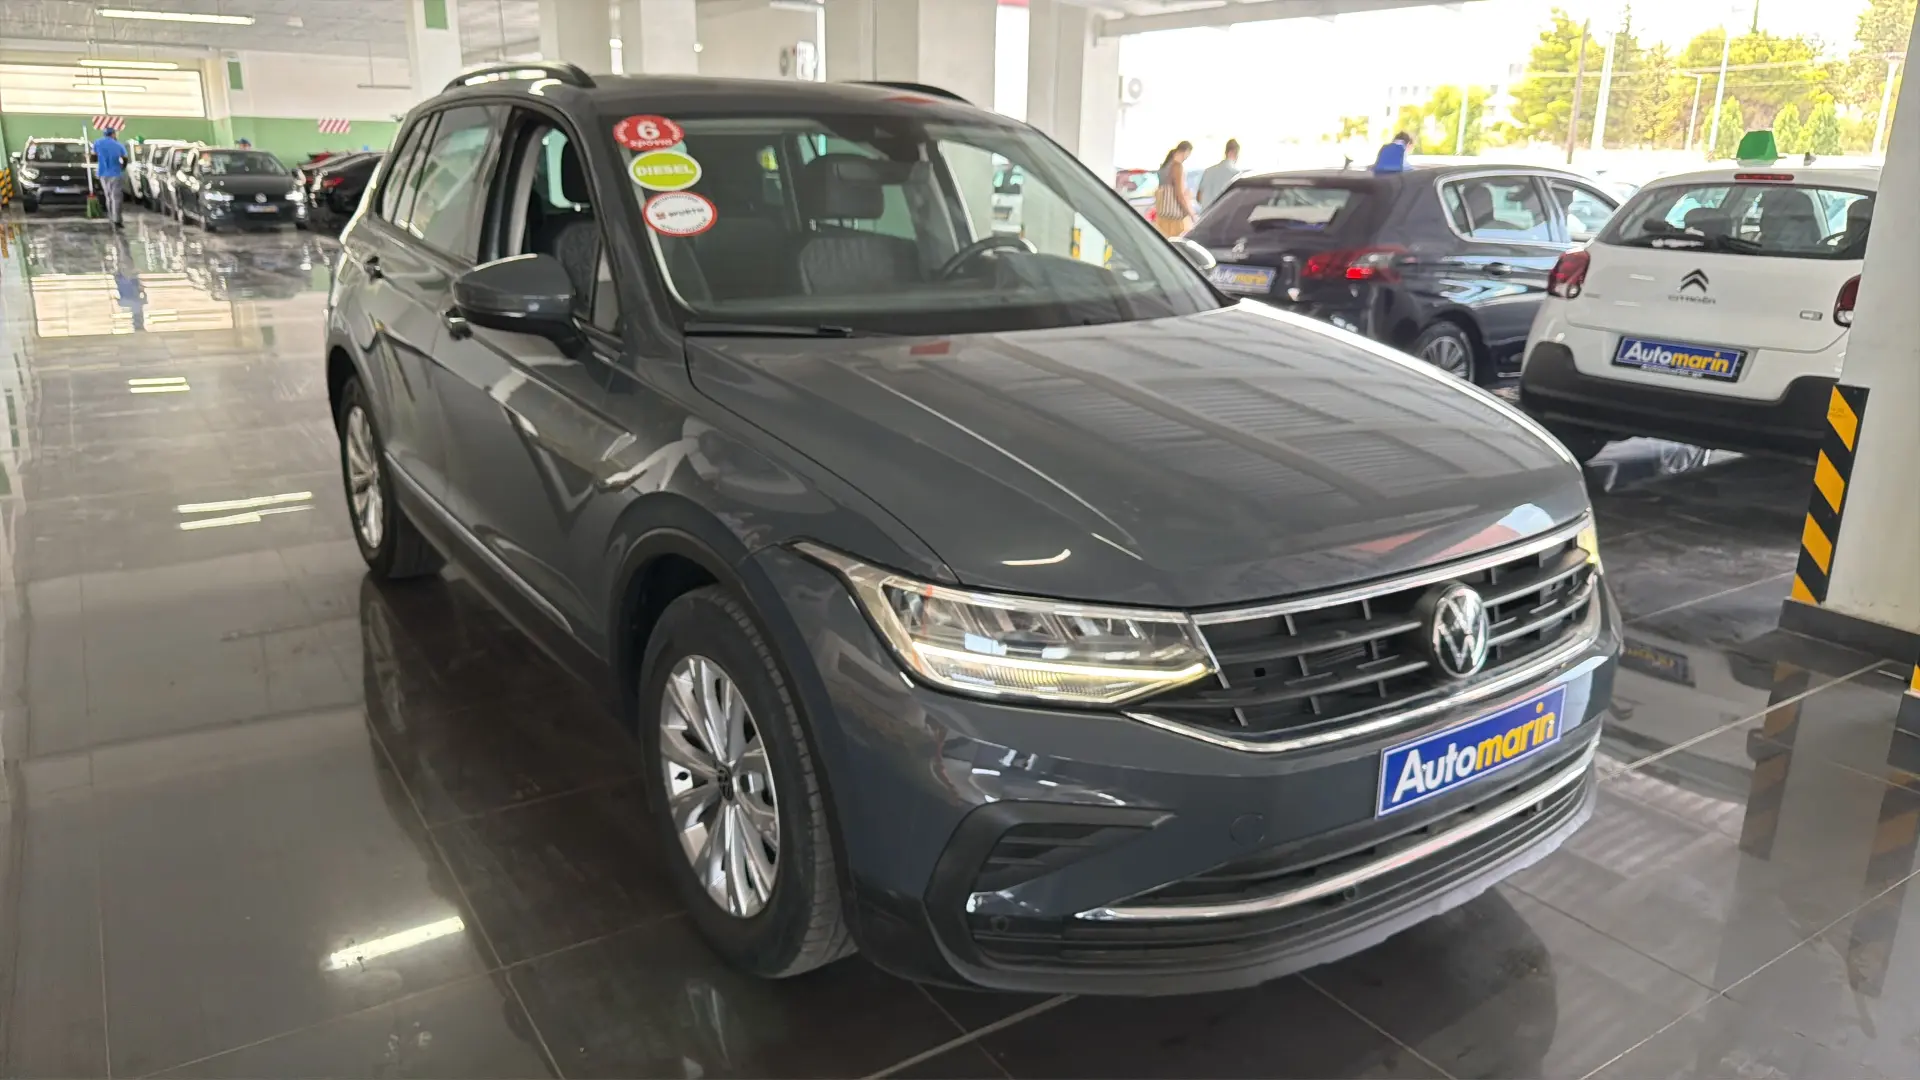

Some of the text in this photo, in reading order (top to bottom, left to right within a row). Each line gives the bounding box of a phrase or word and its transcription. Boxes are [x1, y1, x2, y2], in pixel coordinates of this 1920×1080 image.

[635, 164, 695, 177] DIESEL
[1623, 340, 1730, 373] Automarin
[1391, 701, 1556, 804] Automarin
